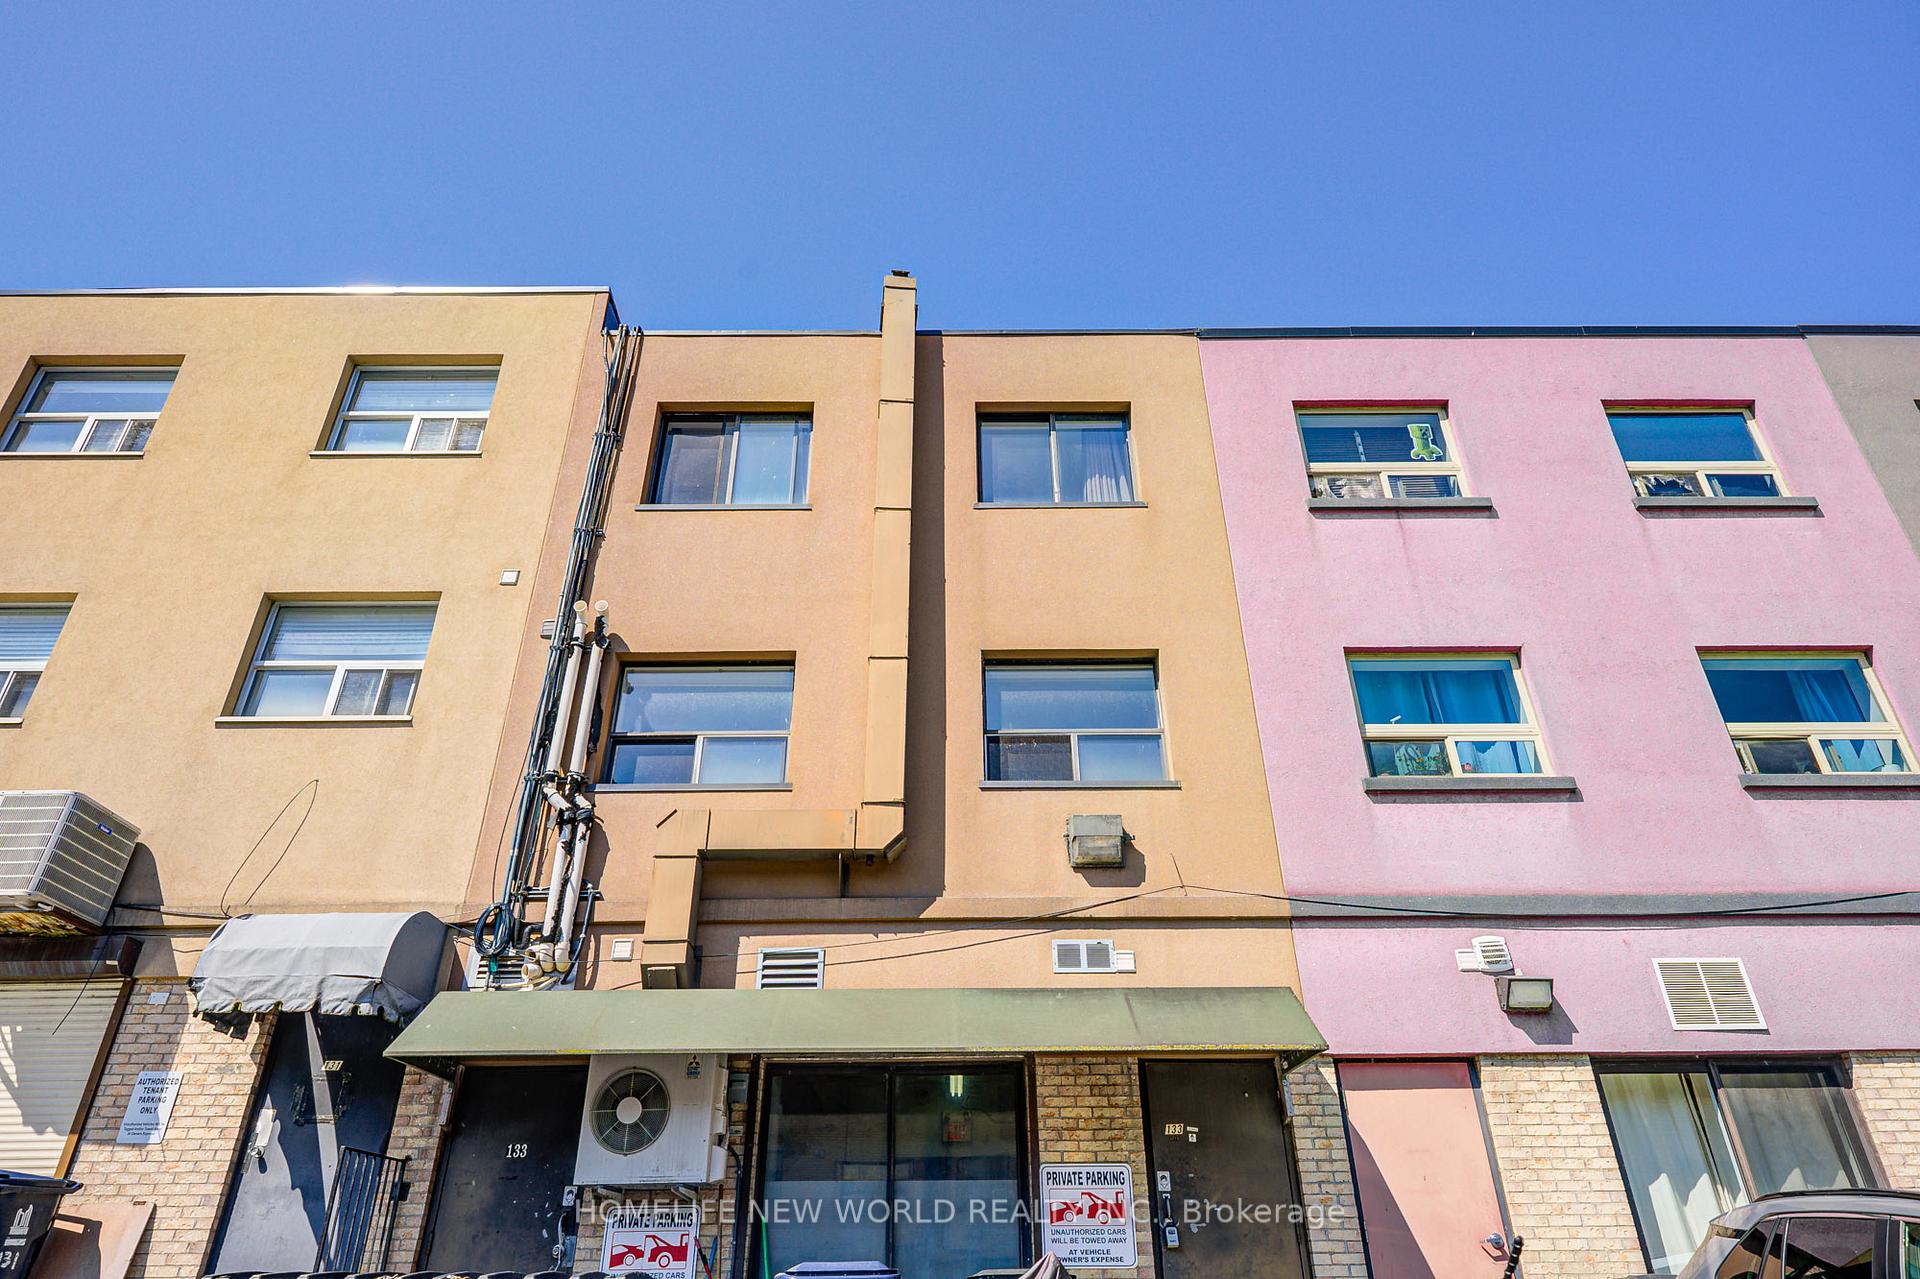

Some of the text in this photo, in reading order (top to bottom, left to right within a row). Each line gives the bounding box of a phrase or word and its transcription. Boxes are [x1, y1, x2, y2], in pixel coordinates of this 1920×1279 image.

[324, 1061, 342, 1070] 131
[137, 1096, 167, 1104] PARKING
[140, 1106, 158, 1114] ONLY
[1167, 1124, 1182, 1134] 133
[506, 1143, 528, 1158] 133
[1046, 1171, 1125, 1186] PRIVATE PARKING
[612, 1212, 693, 1228] PRIVATE PARKING
